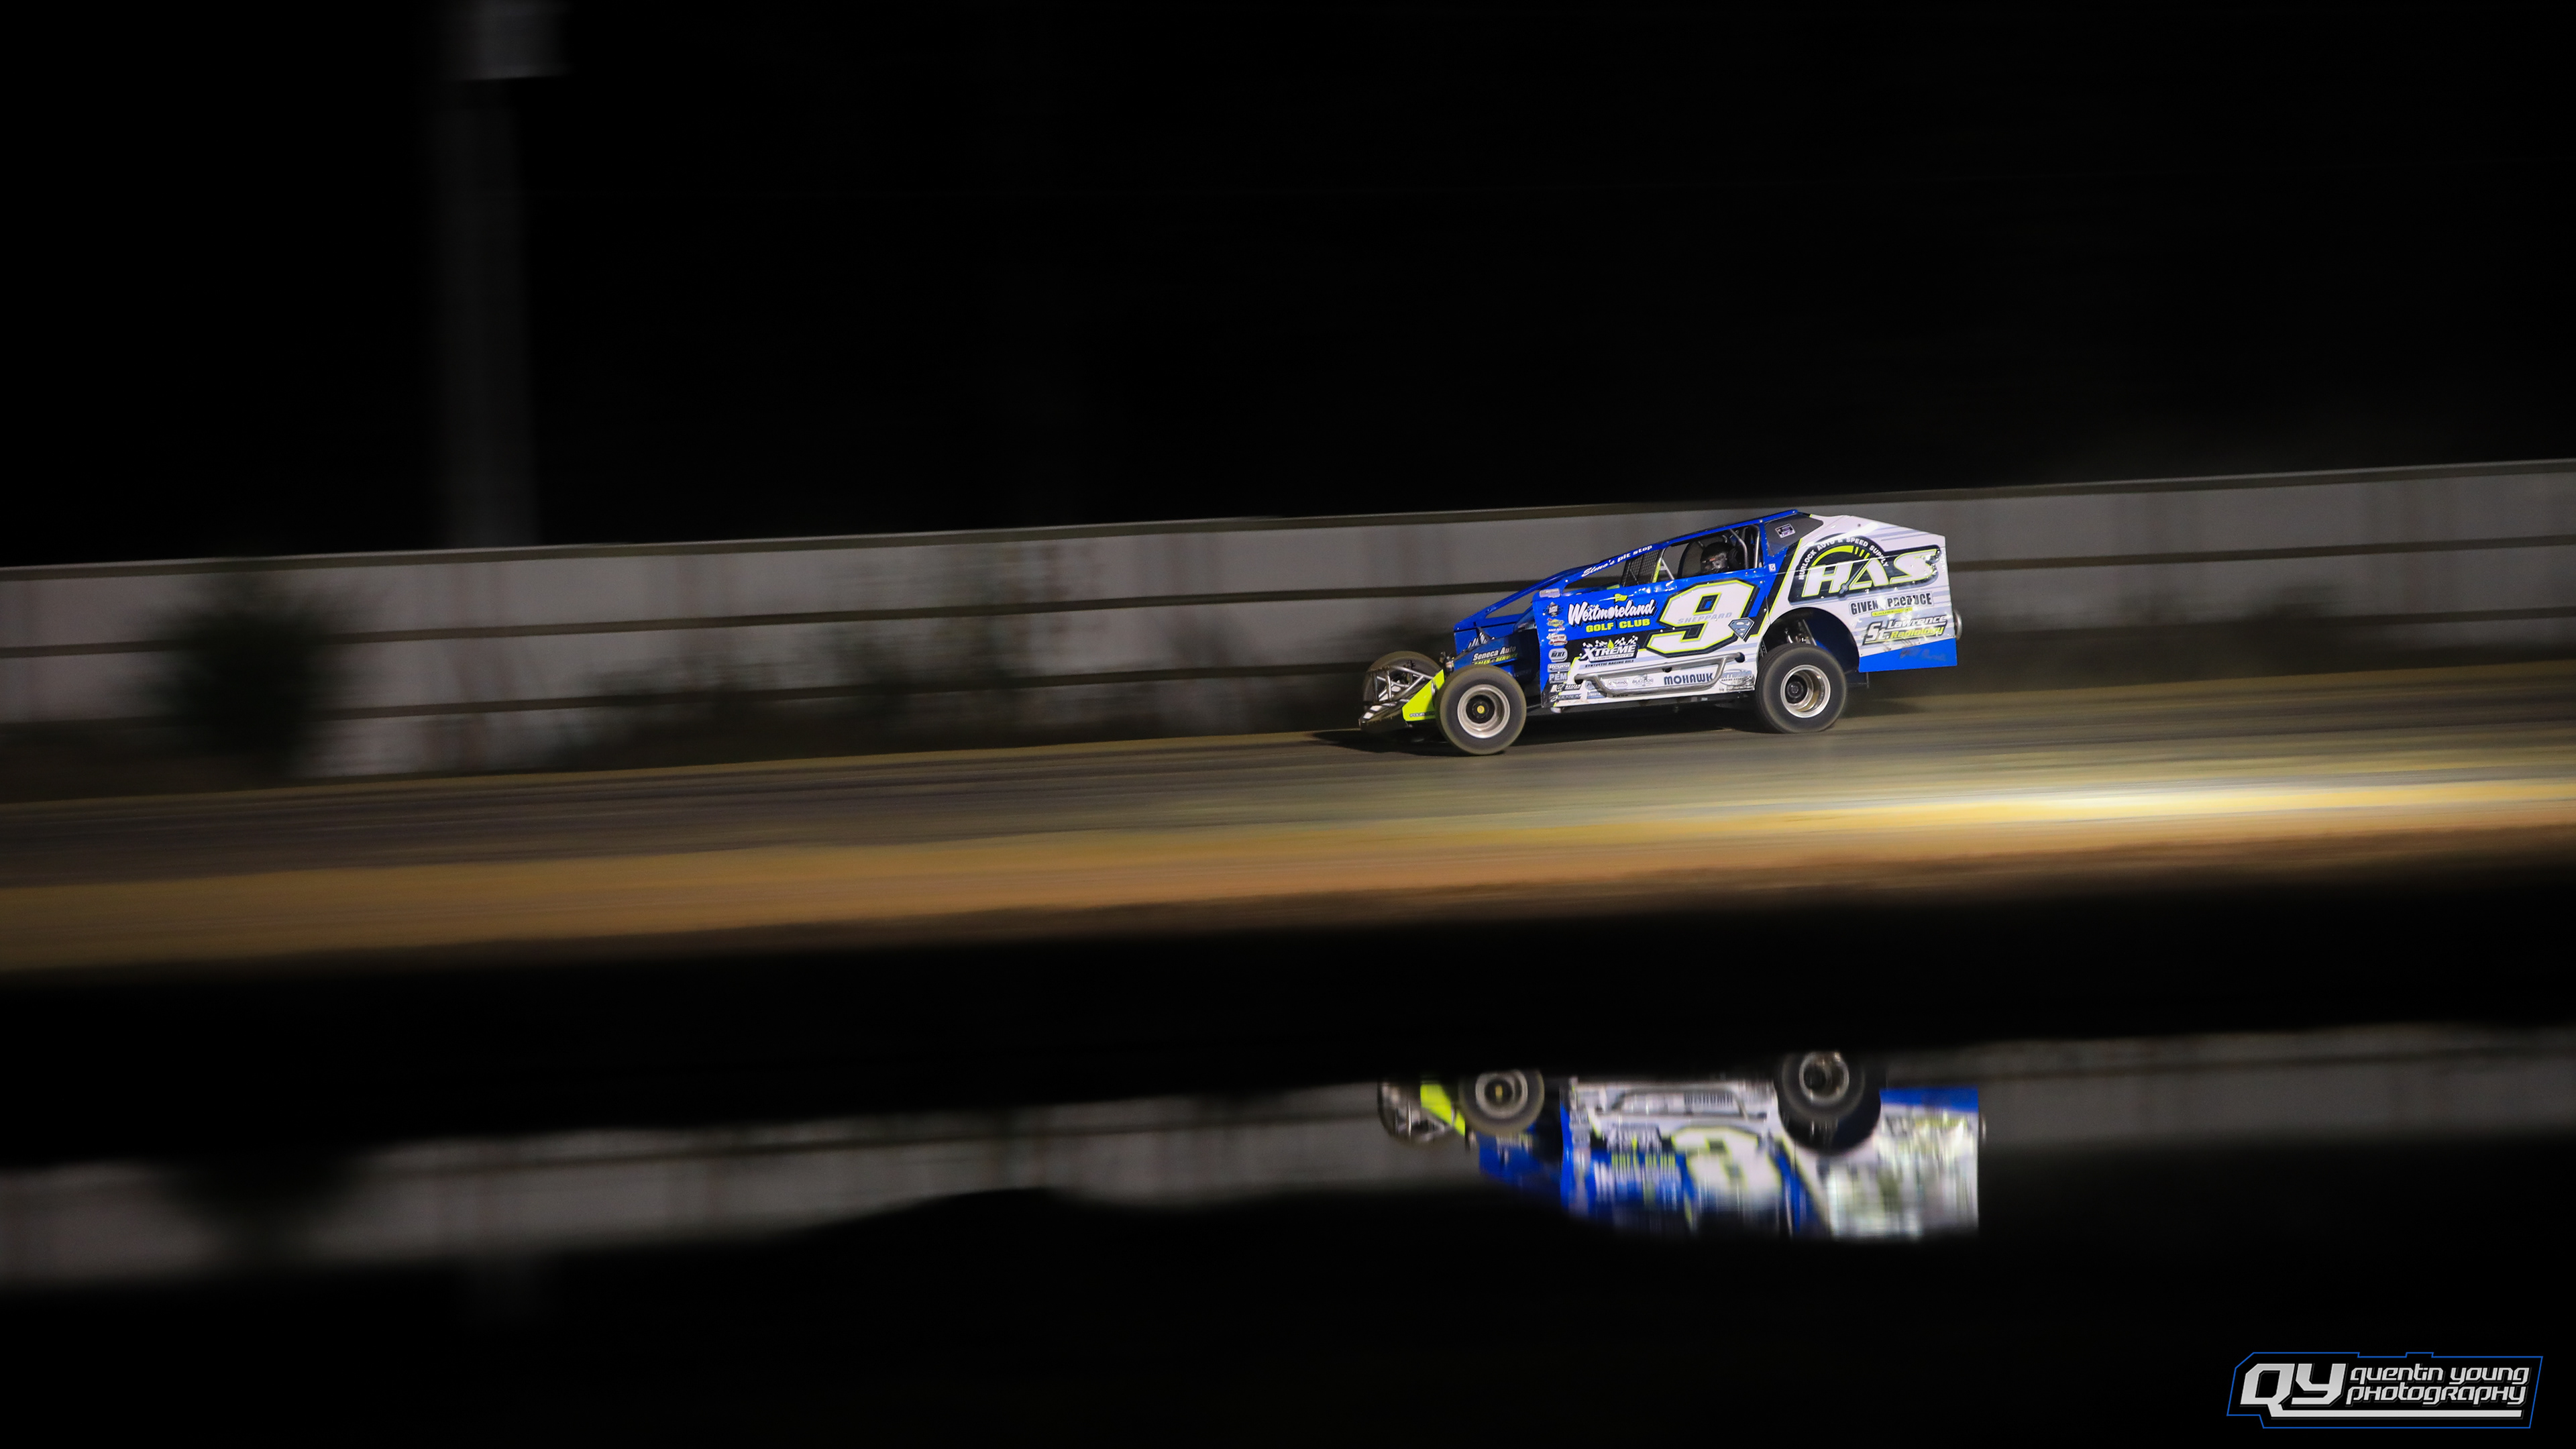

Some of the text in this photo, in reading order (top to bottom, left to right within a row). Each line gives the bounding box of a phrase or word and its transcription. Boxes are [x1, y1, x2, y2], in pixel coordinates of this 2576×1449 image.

[1617, 553, 1631, 563] pit
[1633, 545, 1653, 555] stop
[1799, 549, 1817, 580] HURLOCK
[1817, 541, 1835, 551] AUTO
[1846, 537, 1869, 547] SPEED
[1869, 545, 1889, 567] SUPPLY
[1801, 548, 1938, 598] HAS
[1568, 599, 1656, 626] Westmoreland
[1850, 600, 1878, 616] GIVEN
[1646, 579, 1755, 655] 9
[1677, 612, 1733, 625] SHEPPARD
[1888, 614, 1947, 629] Lawrence
[1586, 619, 1650, 633] GOLF CLUB
[1890, 626, 1945, 638] Radiology
[1472, 646, 1516, 661] Seneca Auto
[1580, 644, 1637, 662] XTREME
[1549, 672, 1567, 681] PEM
[1664, 673, 1713, 686] MOHAWK
